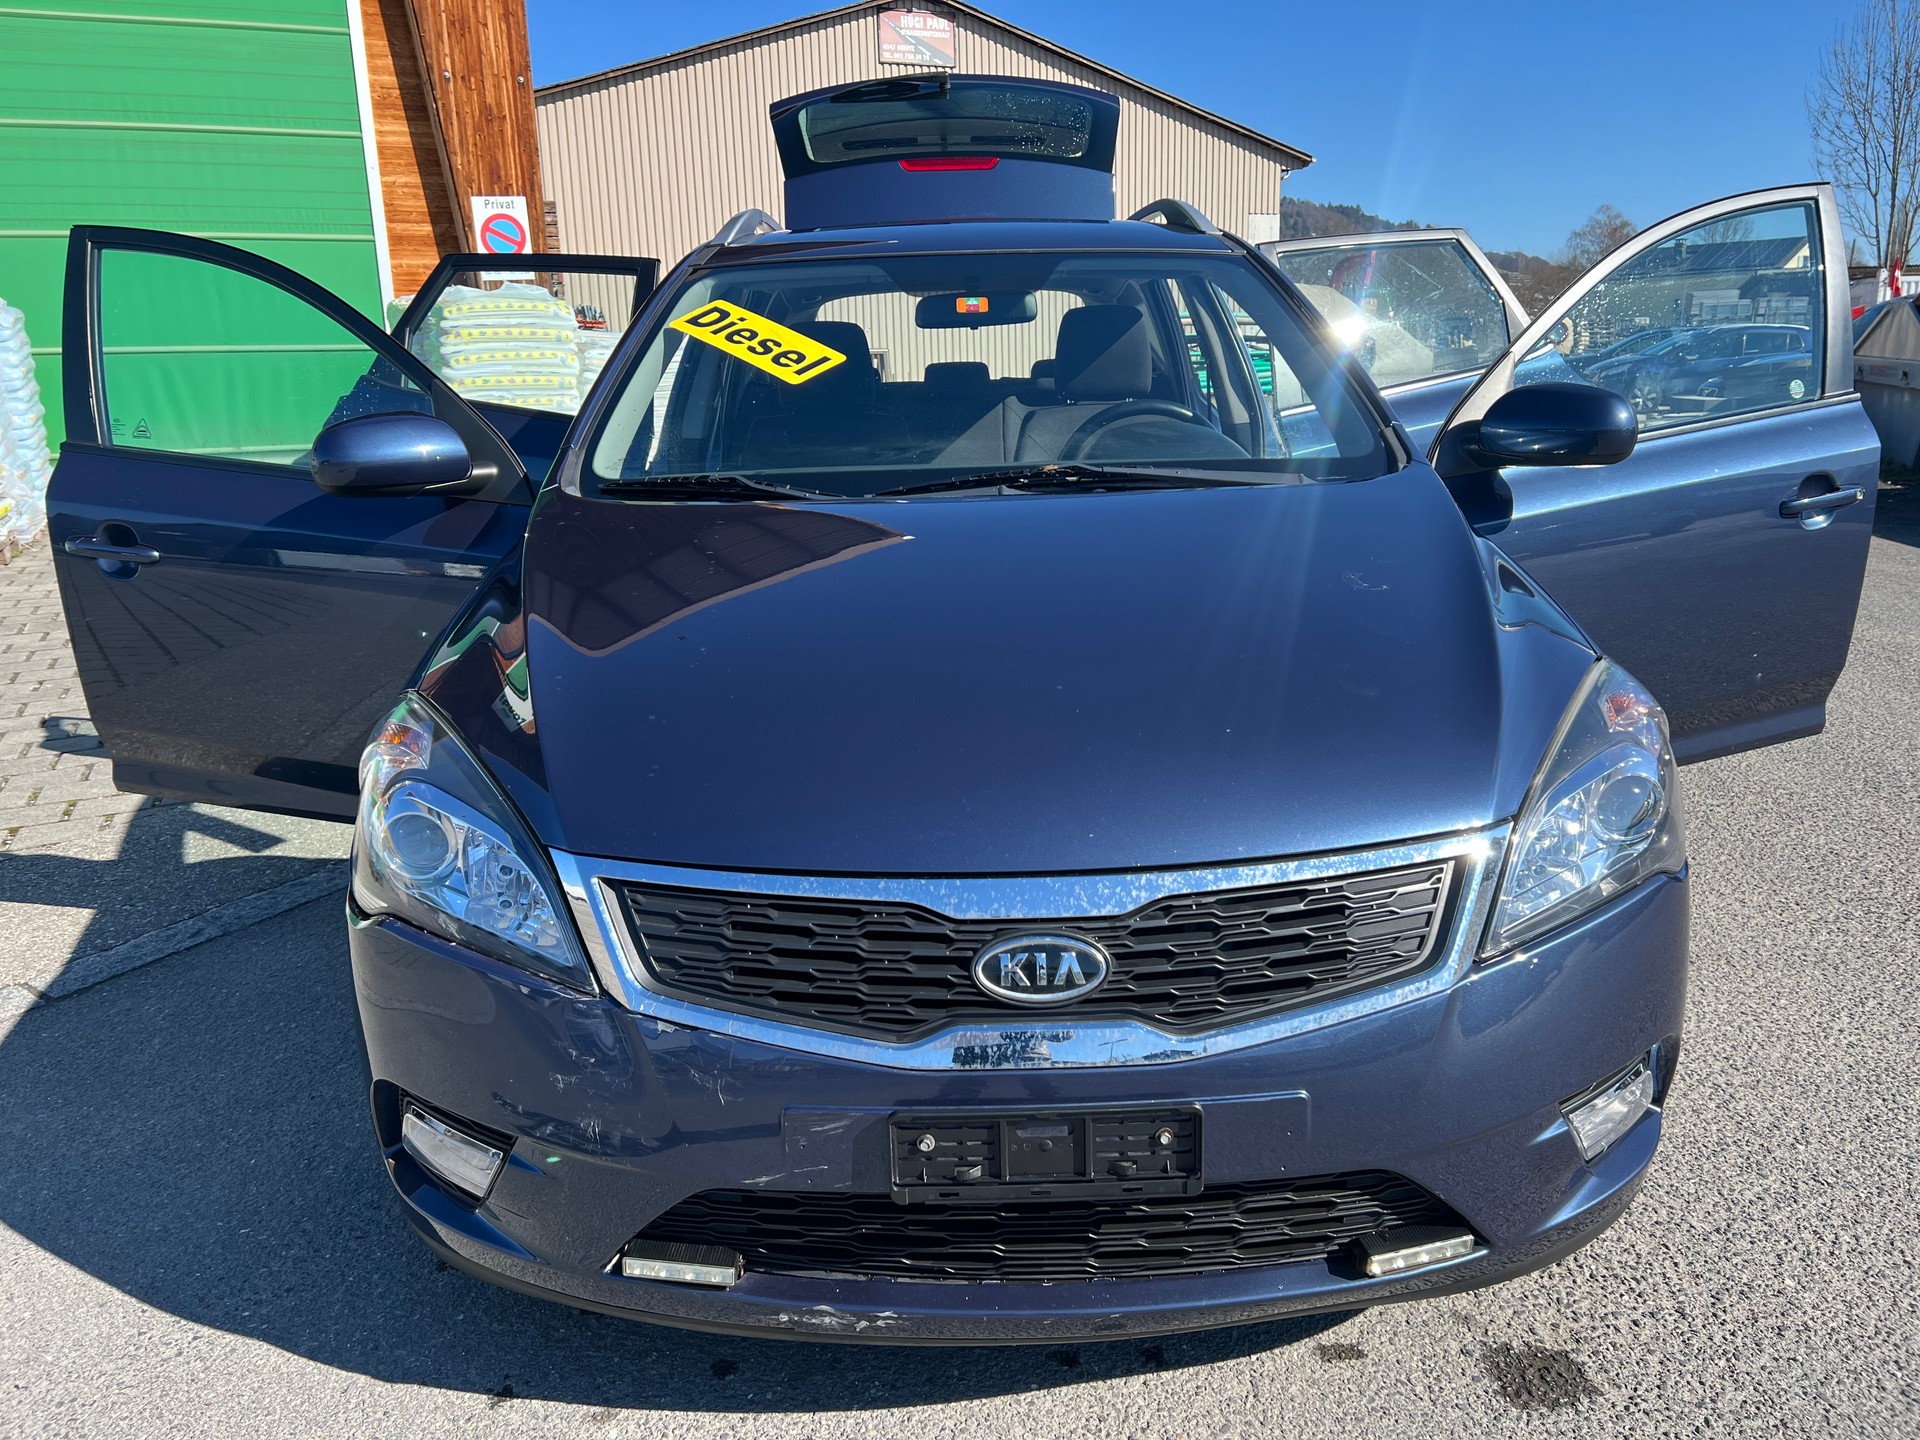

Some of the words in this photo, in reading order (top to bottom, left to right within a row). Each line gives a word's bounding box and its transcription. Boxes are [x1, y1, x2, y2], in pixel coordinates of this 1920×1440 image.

[926, 17, 950, 30] PAUL
[484, 199, 515, 209] Privat
[684, 306, 832, 376] Diesel
[998, 952, 1086, 986] KIA
